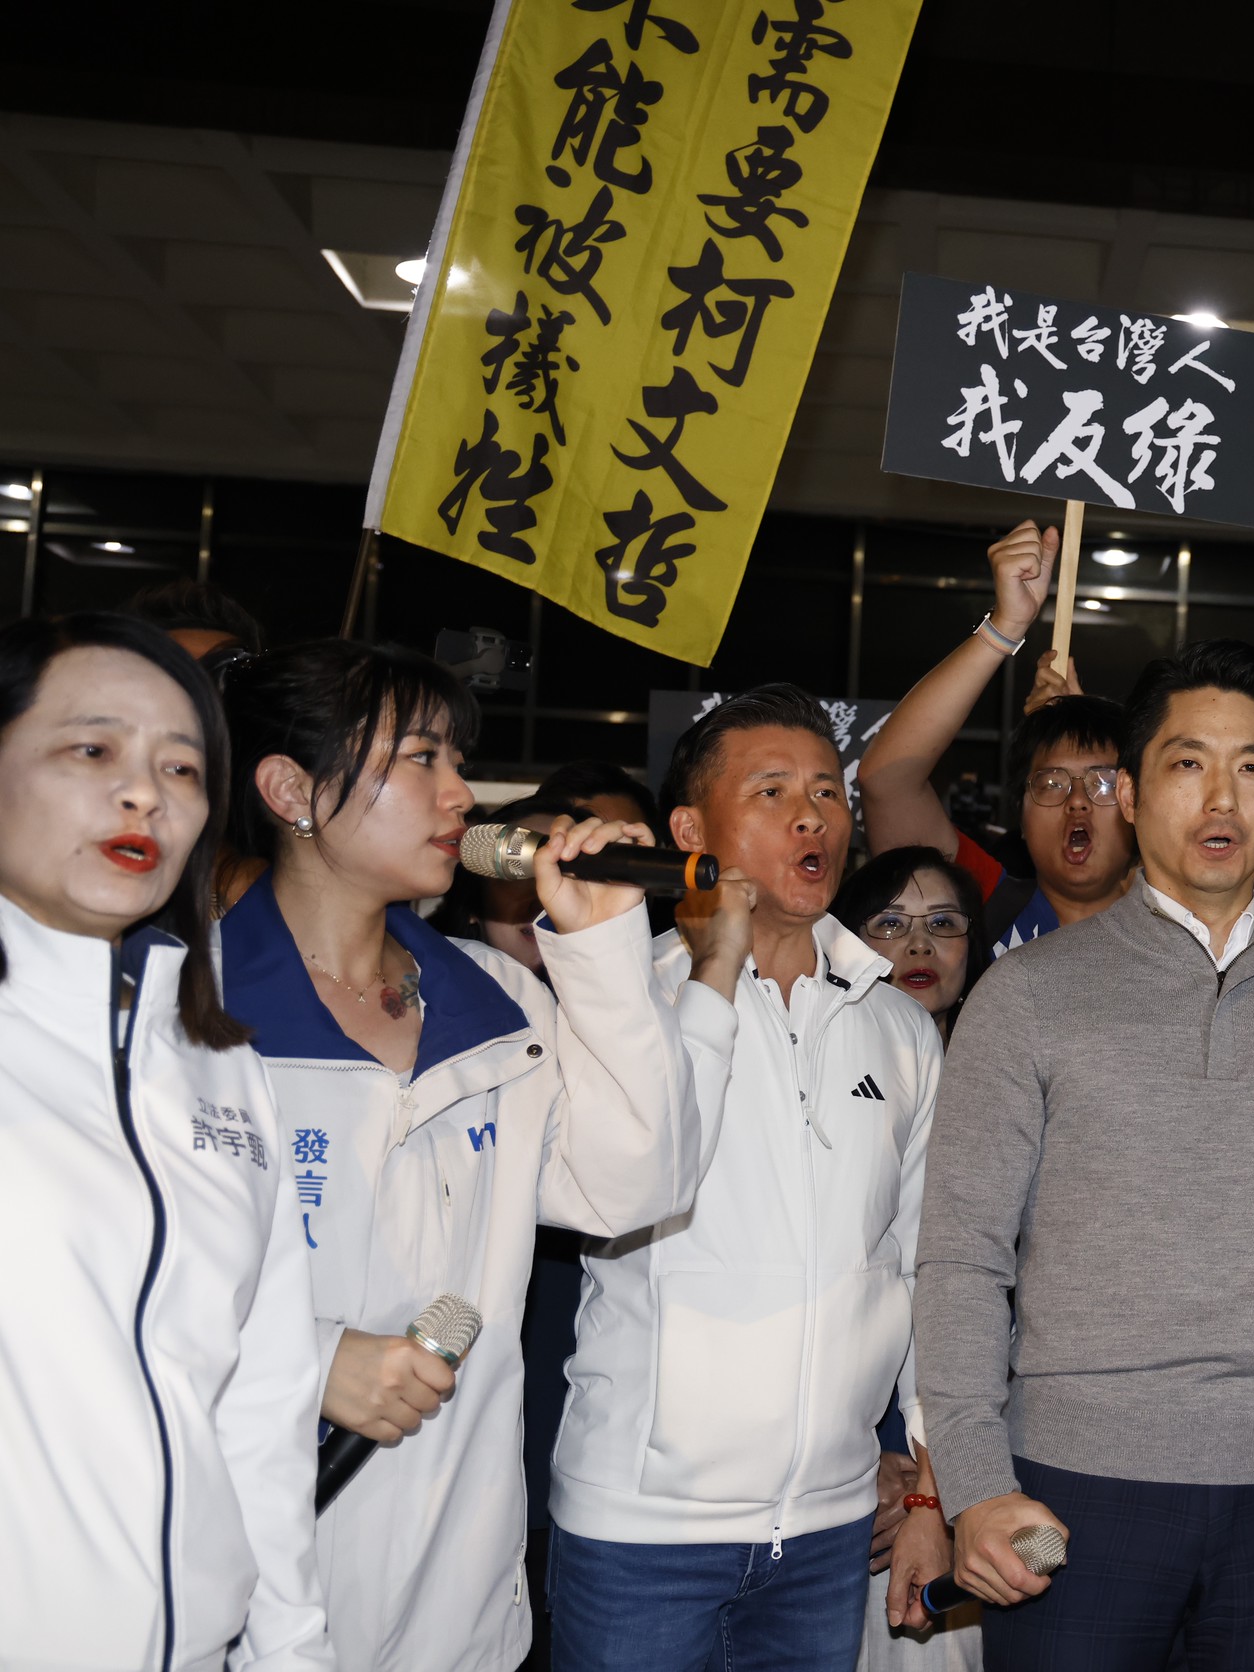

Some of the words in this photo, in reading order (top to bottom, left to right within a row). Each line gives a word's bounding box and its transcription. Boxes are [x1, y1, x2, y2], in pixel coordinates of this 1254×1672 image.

[957, 285, 1236, 394] 我是台灣人
[941, 364, 1222, 515] 我反綠
